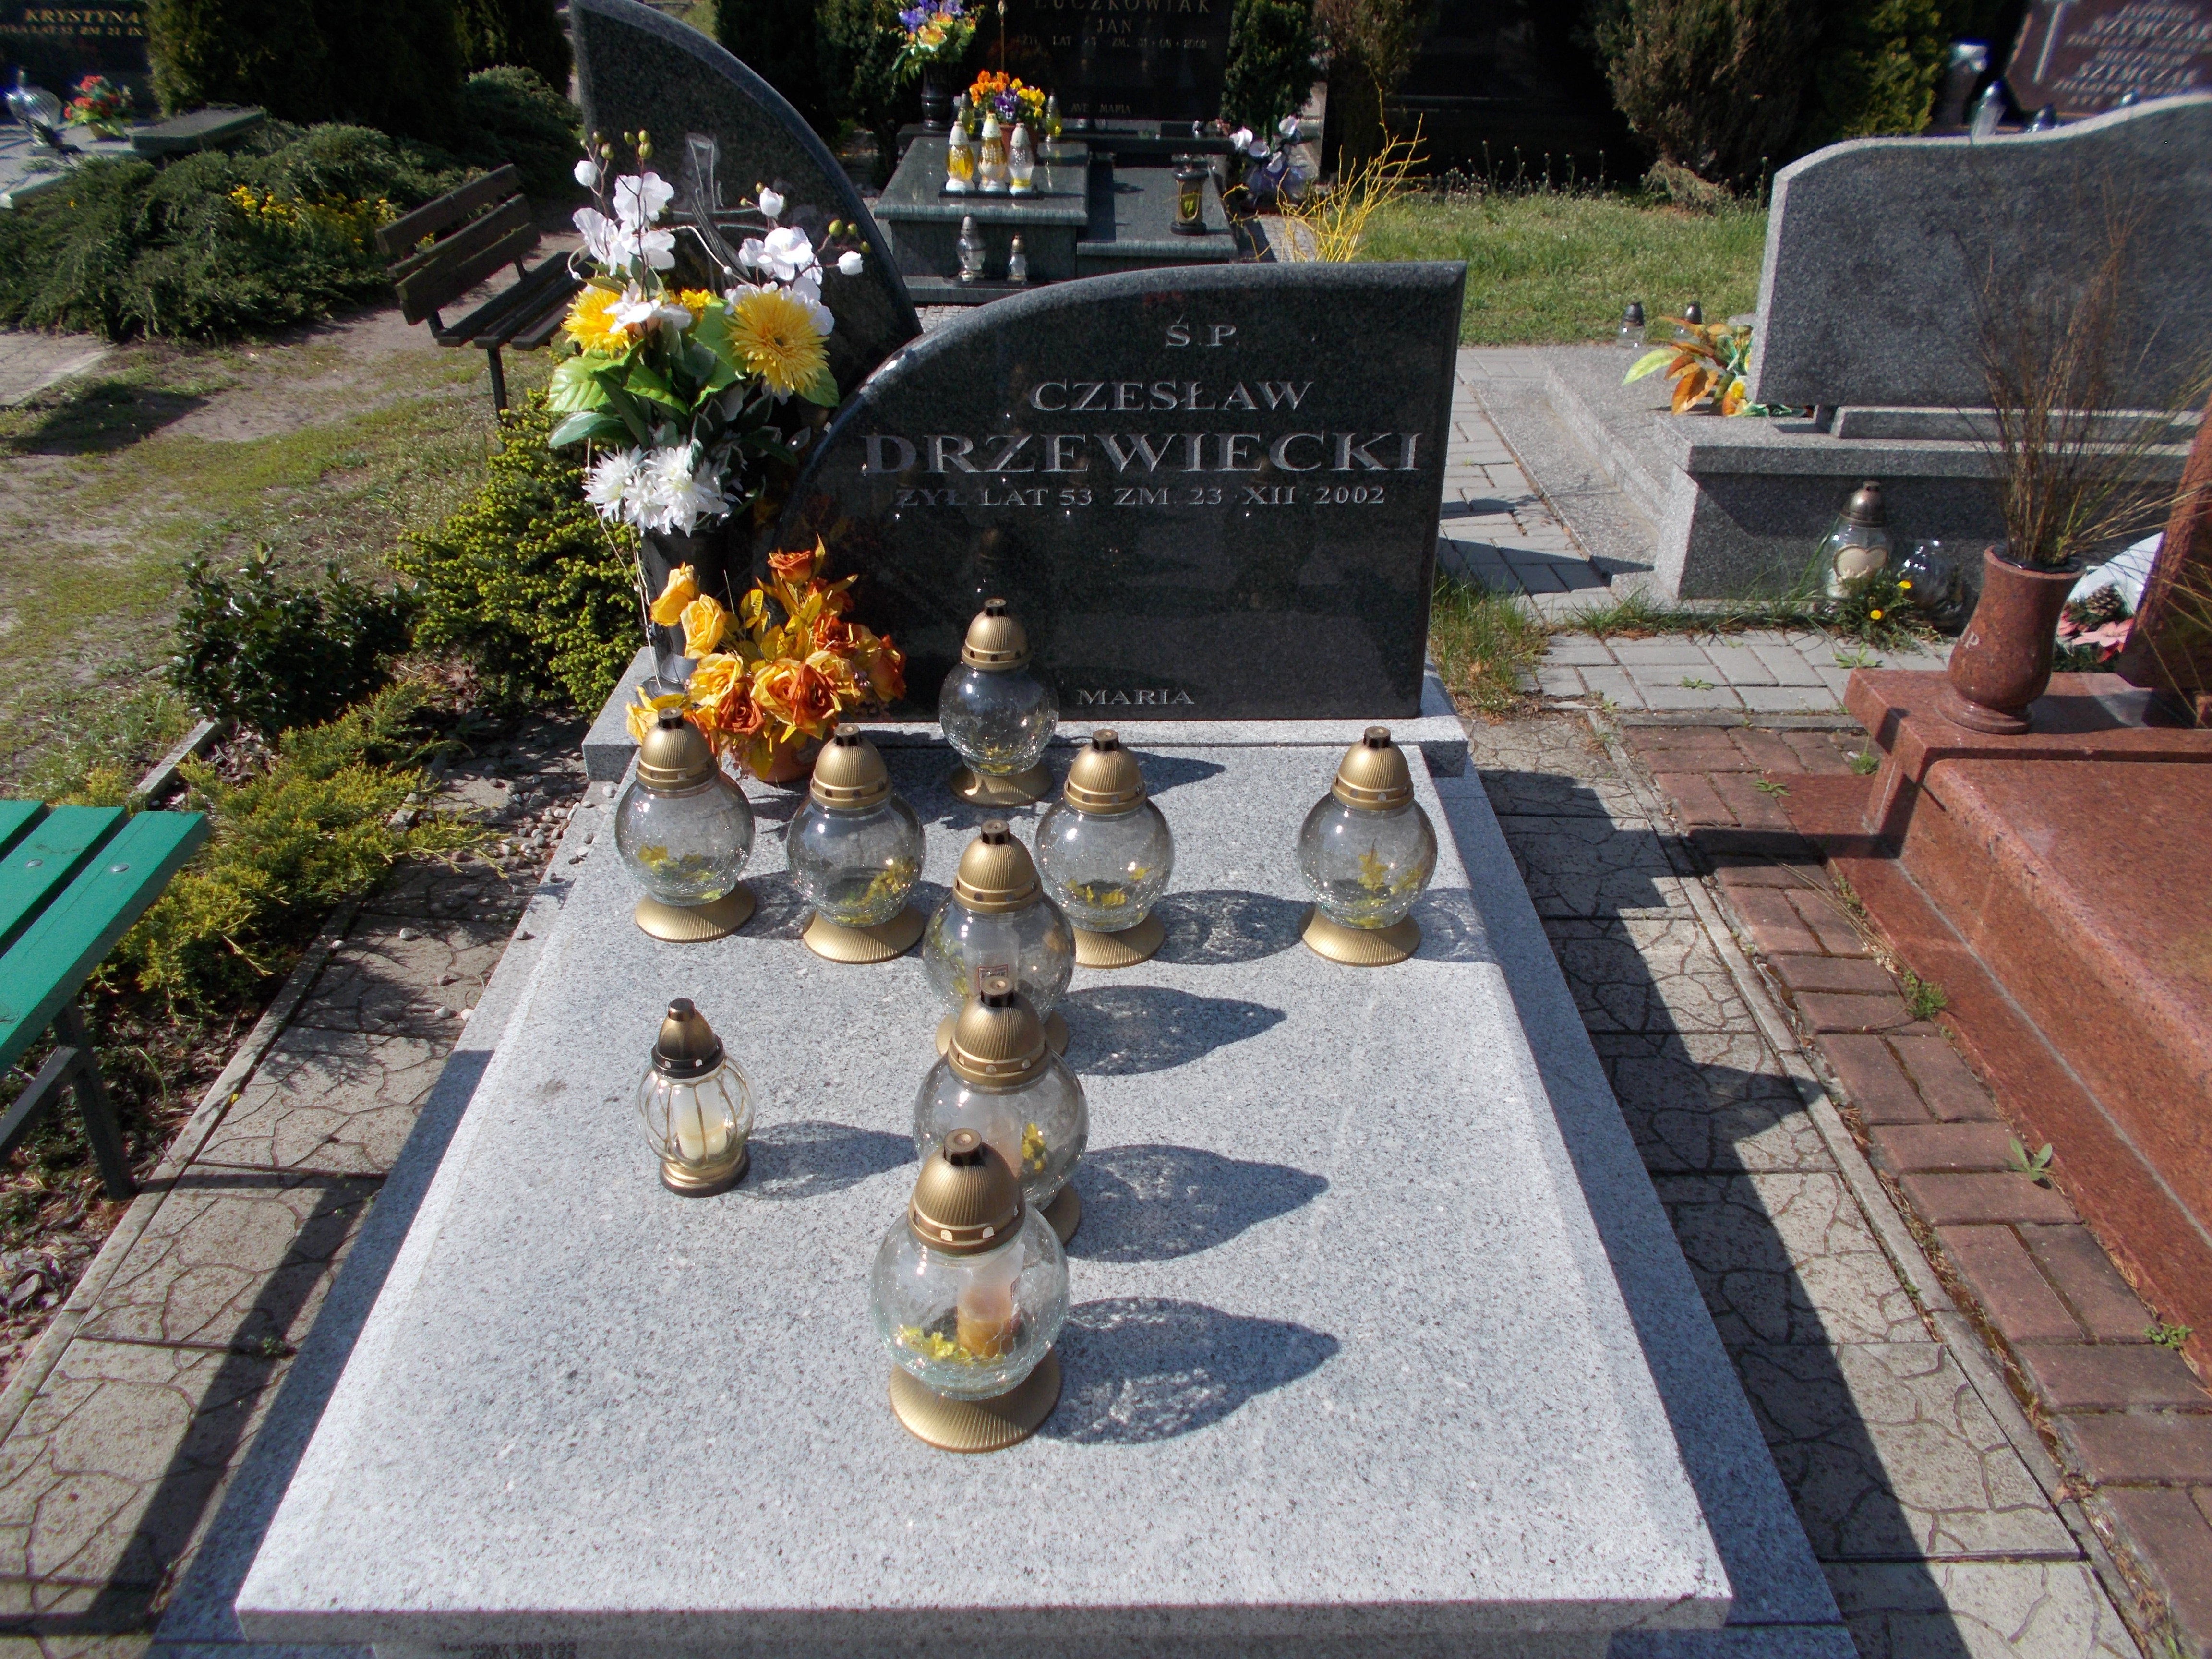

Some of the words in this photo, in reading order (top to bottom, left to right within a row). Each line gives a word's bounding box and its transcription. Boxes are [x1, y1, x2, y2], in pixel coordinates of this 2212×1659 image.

[25, 8, 139, 23] KRYSTYNA
[1097, 17, 1133, 34] JAN
[1070, 102, 1090, 113] AVE
[1099, 103, 1131, 114] MARIA
[1028, 378, 1315, 411] CZESŁAW
[863, 431, 1422, 473] DRZEWIECKI
[978, 488, 1049, 506] LAT
[1059, 488, 1092, 506] 53
[1188, 487, 1222, 505] 23
[1242, 486, 1297, 505] XII
[1313, 486, 1386, 505] 2002
[1076, 689, 1195, 705] MARIA
